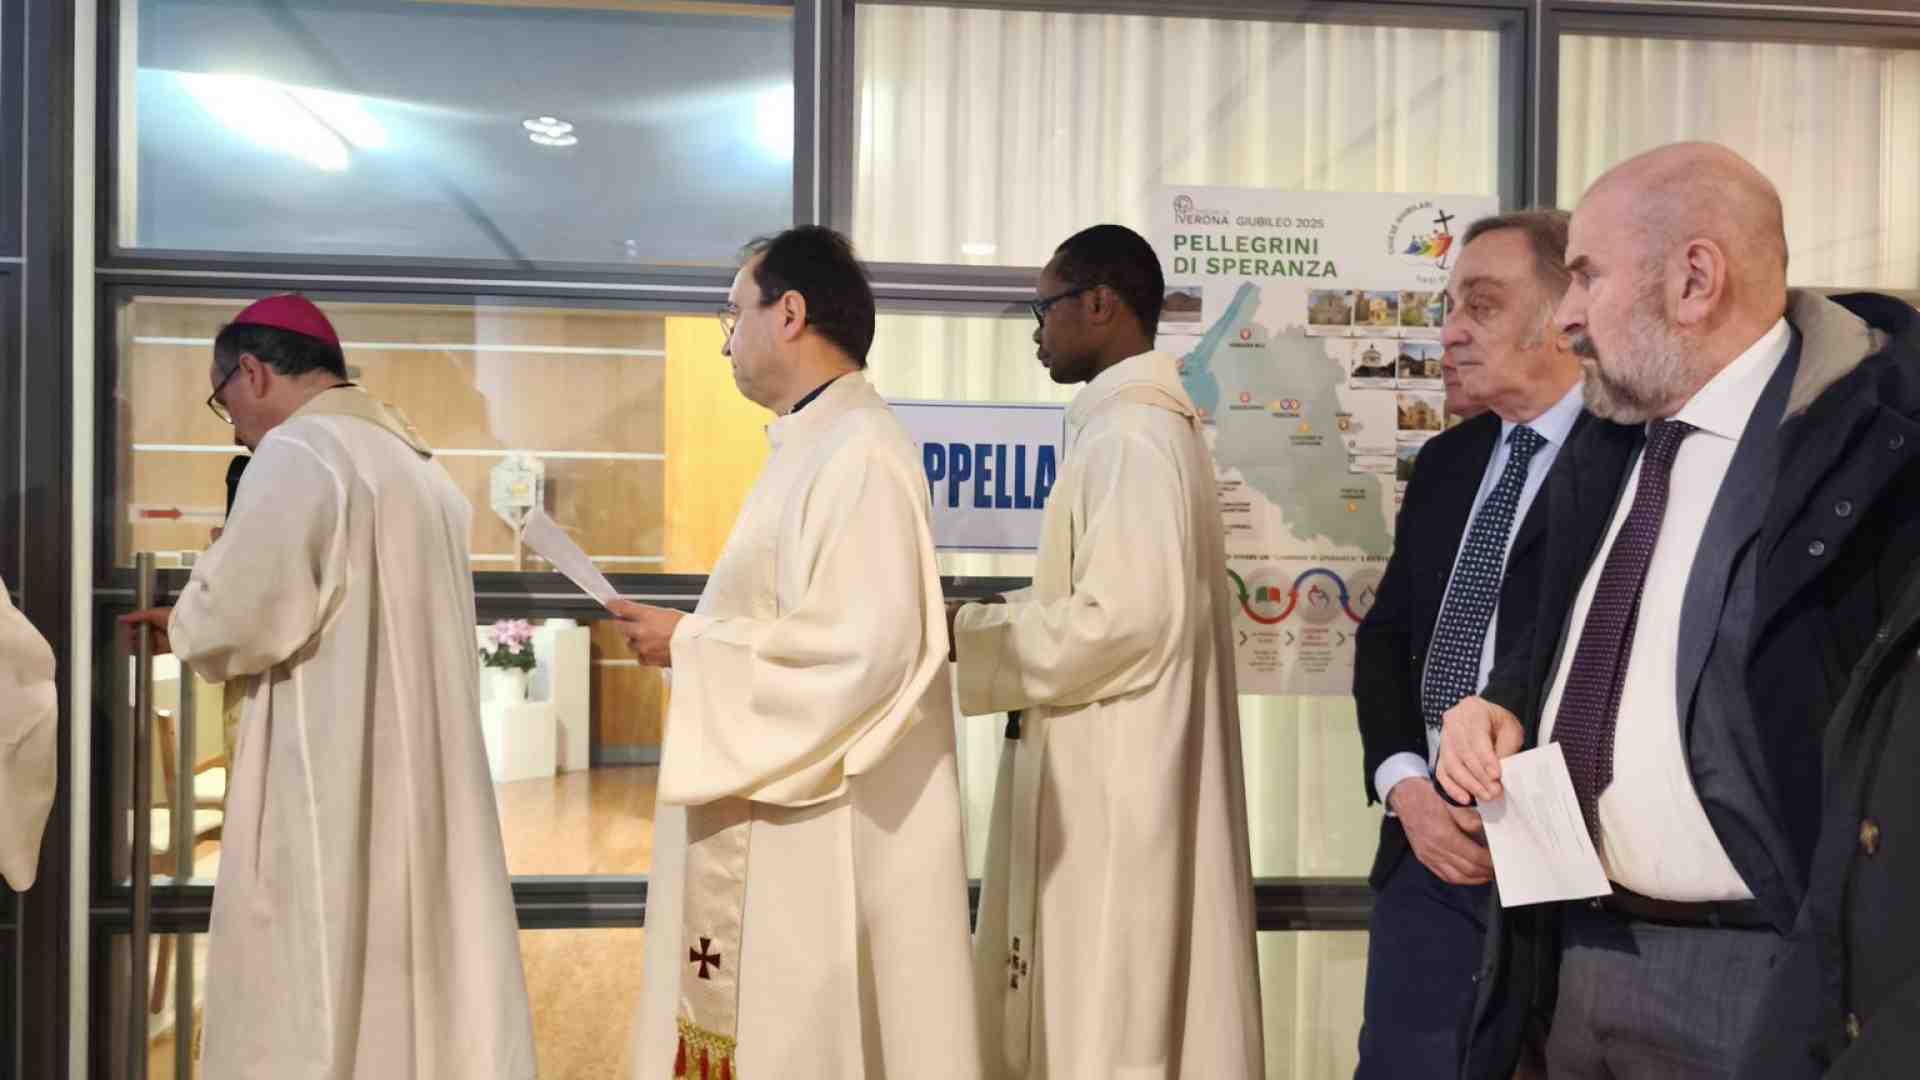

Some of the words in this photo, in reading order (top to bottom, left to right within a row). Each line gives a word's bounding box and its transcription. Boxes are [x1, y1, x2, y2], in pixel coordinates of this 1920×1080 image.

[1178, 214, 1229, 225] VERONA
[1236, 216, 1292, 228] GIUBILEO
[1295, 217, 1325, 229] 2025
[1173, 234, 1319, 255] PELLEGRINI
[1173, 256, 1197, 275] DI
[1205, 257, 1338, 278] SPERANZA
[923, 442, 1056, 510] PPELLA
